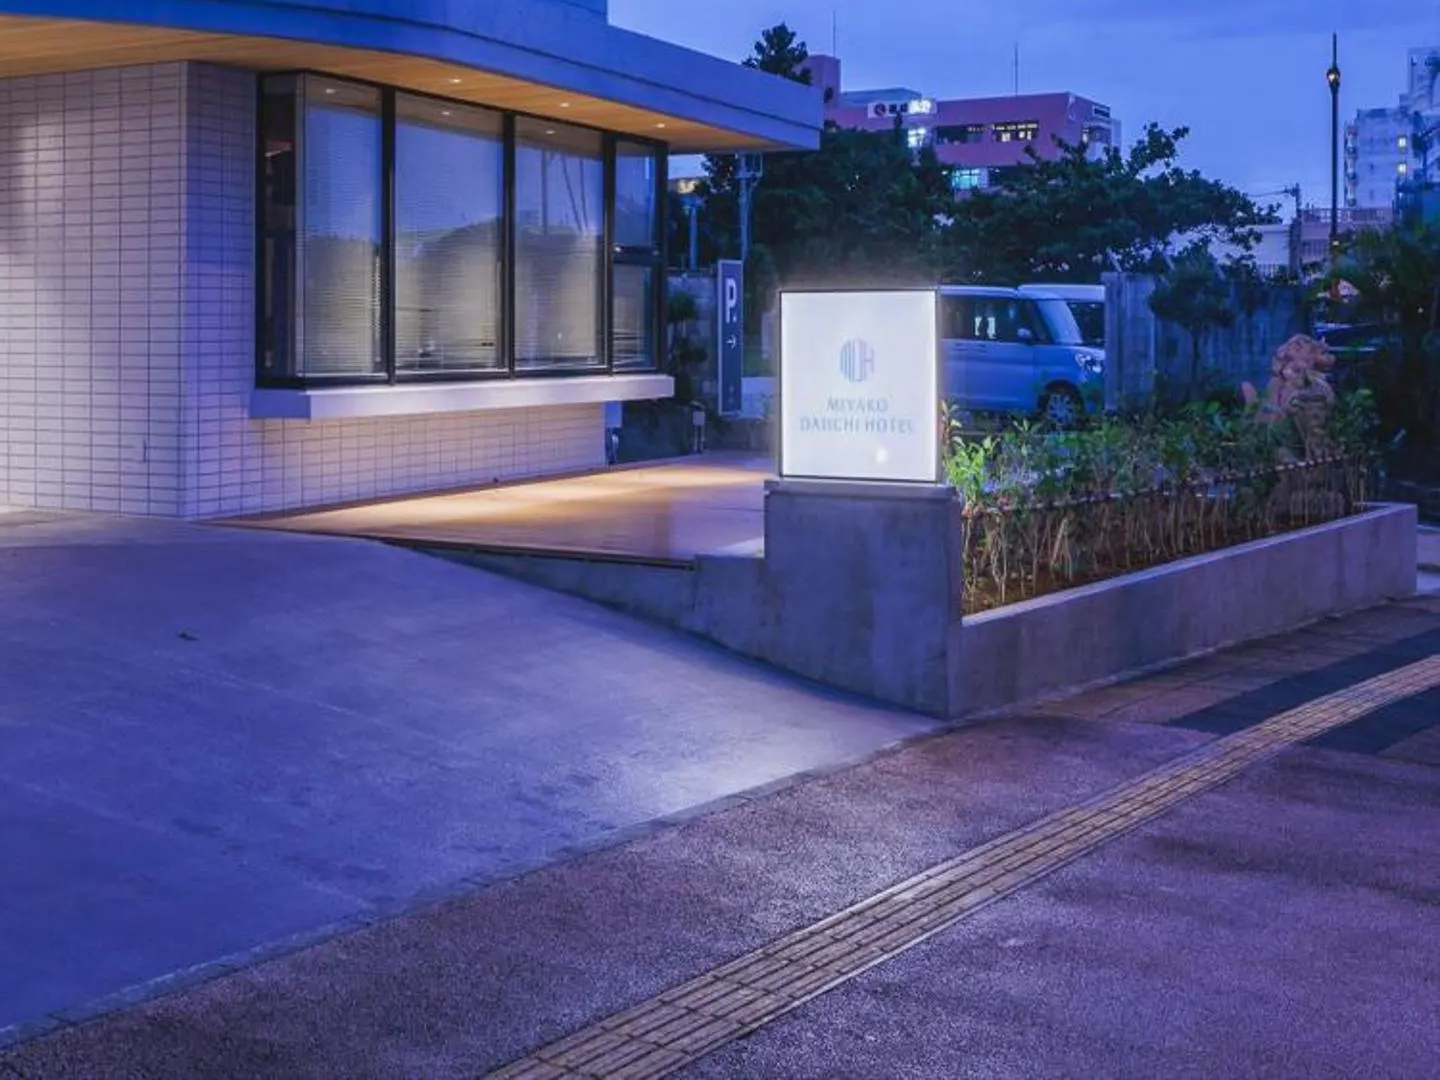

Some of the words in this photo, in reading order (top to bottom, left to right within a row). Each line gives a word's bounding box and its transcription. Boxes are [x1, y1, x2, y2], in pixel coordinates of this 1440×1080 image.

[826, 395, 889, 413] MIYAKO
[799, 416, 860, 433] DAIICHI
[865, 416, 915, 434] HOTEL
